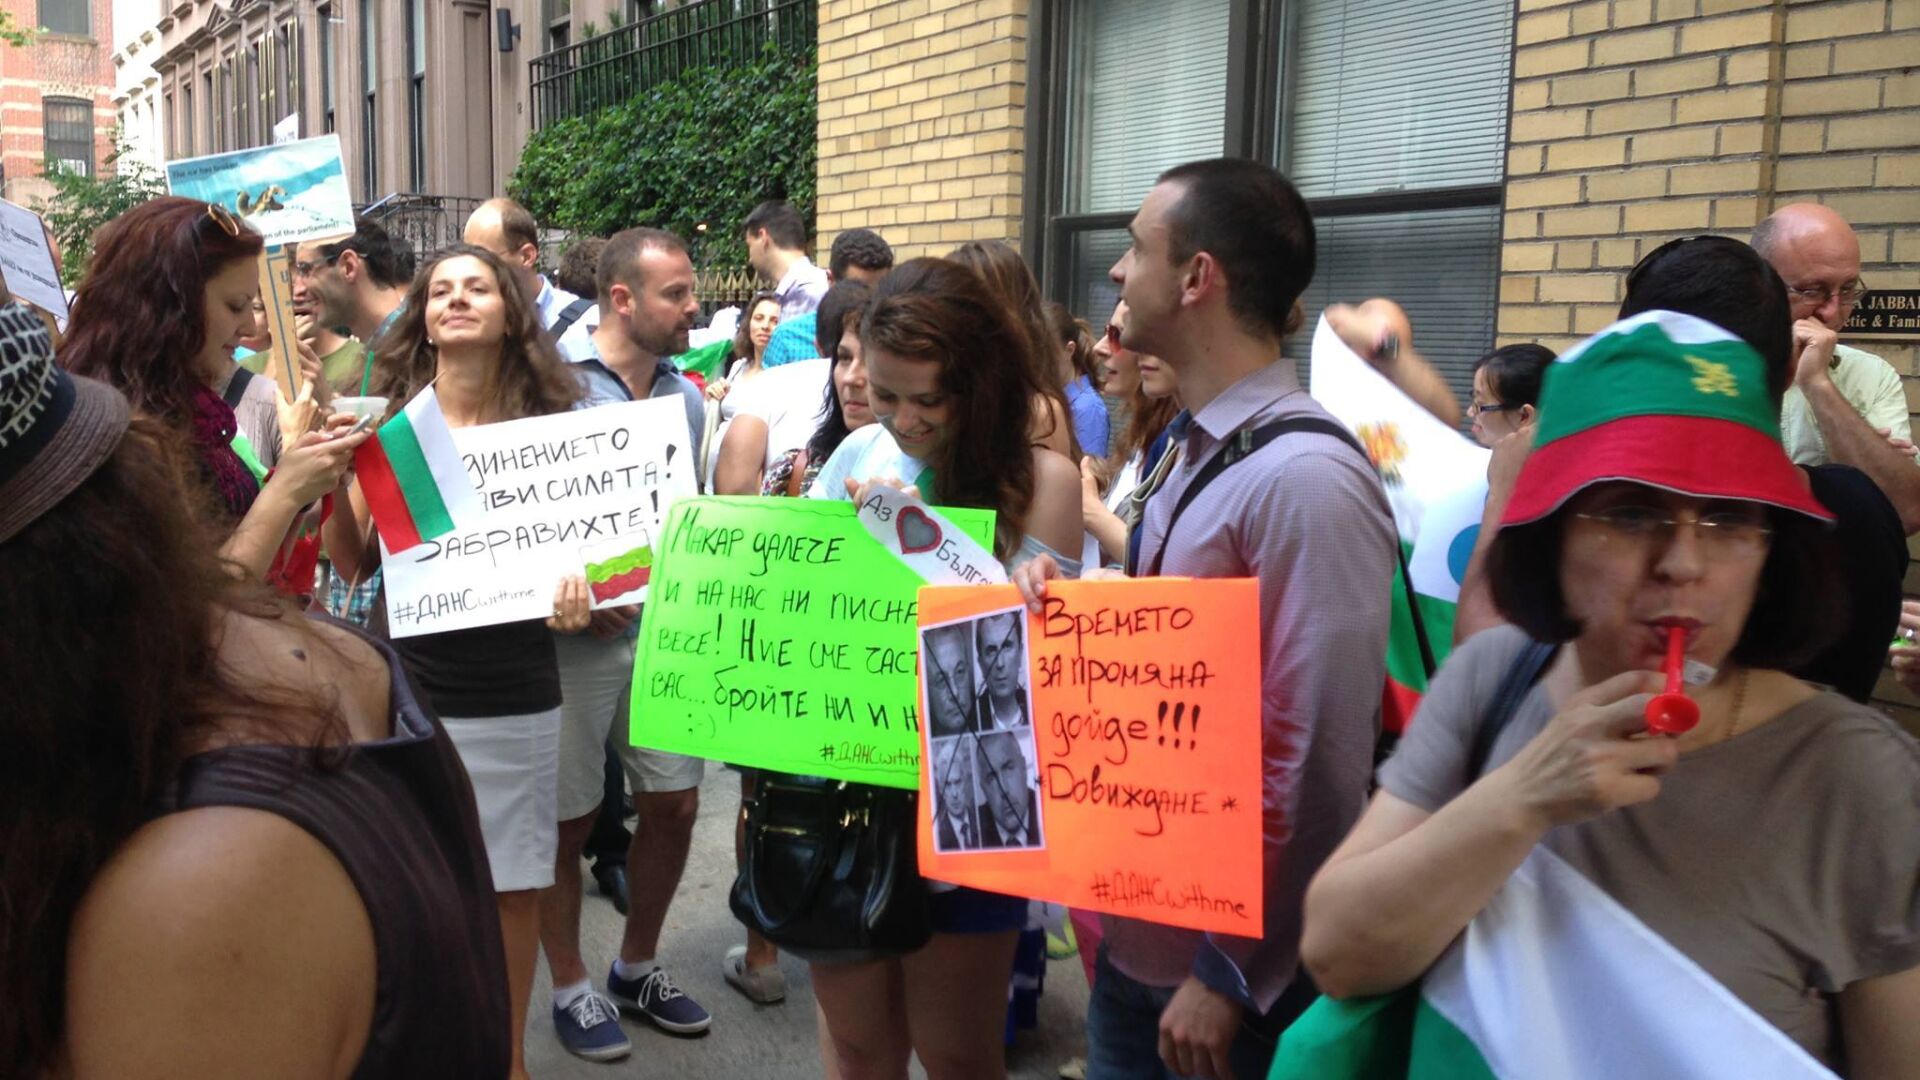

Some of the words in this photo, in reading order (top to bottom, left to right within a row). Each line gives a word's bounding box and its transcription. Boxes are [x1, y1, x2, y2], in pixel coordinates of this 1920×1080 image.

[283, 228, 295, 236] the
[1872, 315, 1882, 328] &
[697, 579, 723, 606] НА
[731, 585, 766, 611] НАС
[781, 590, 810, 615] НИ
[810, 641, 851, 669] СМЕ
[825, 693, 854, 723] НИ
[867, 702, 889, 730] И
